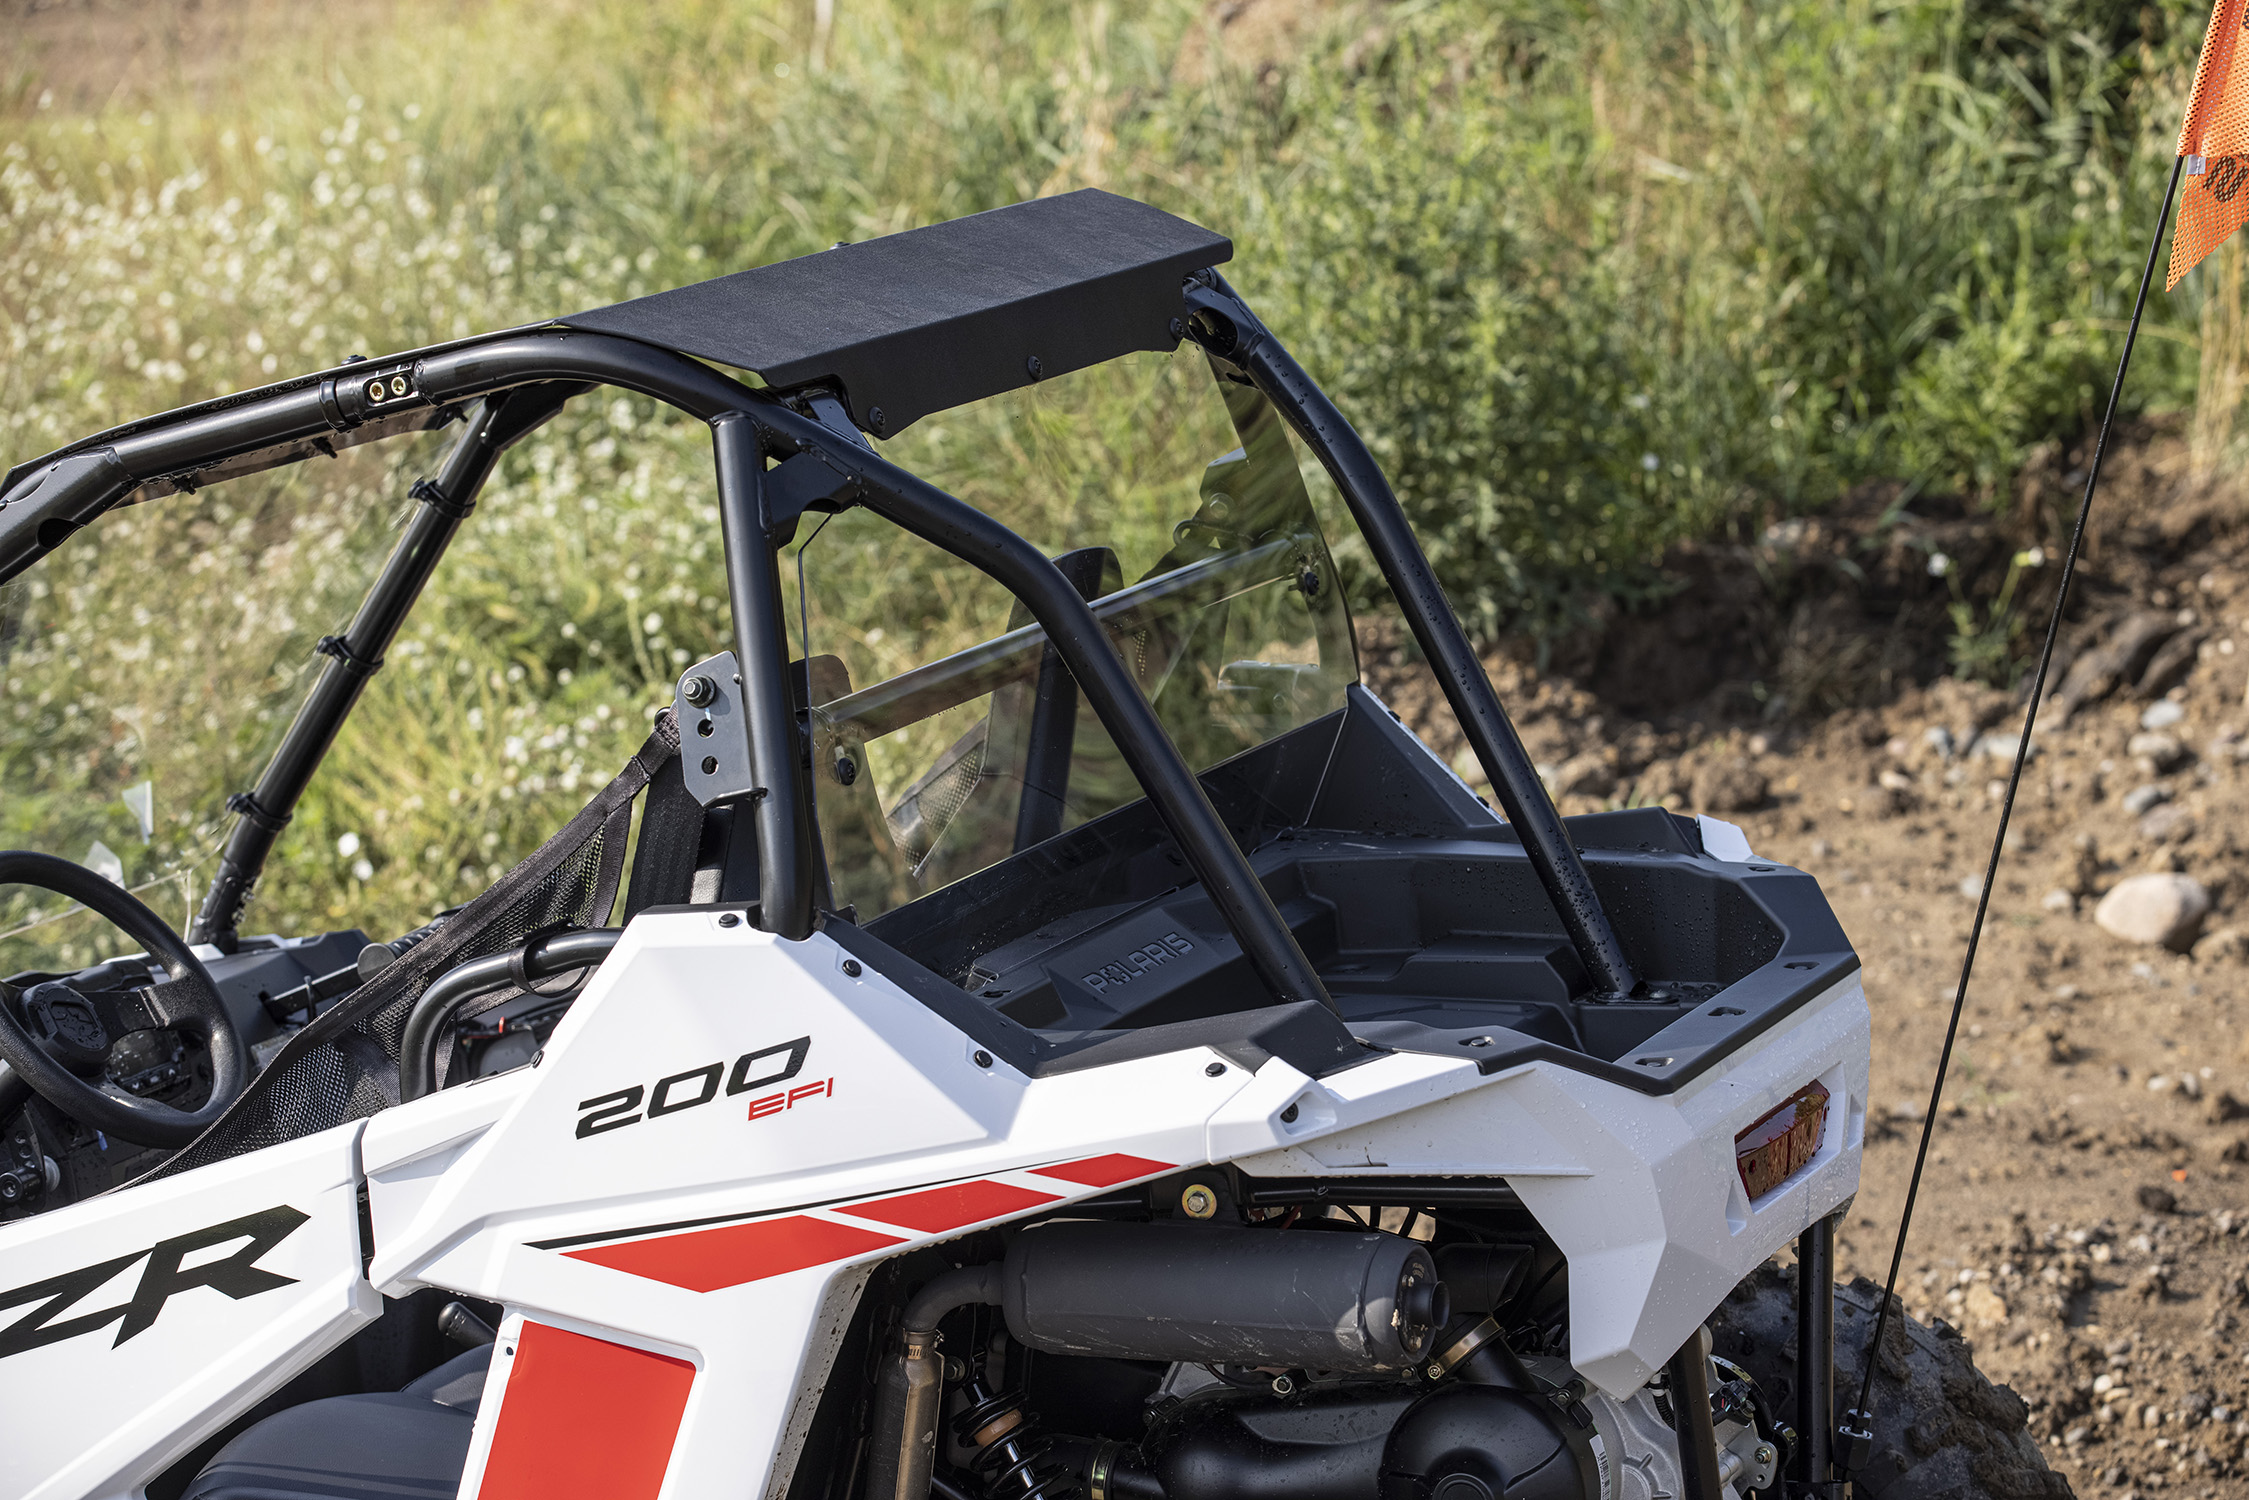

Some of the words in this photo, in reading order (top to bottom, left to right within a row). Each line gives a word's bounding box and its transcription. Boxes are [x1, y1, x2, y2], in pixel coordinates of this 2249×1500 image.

[1081, 931, 1195, 994] POLARIS
[575, 1035, 811, 1140] 200
[748, 1077, 834, 1121] EFI
